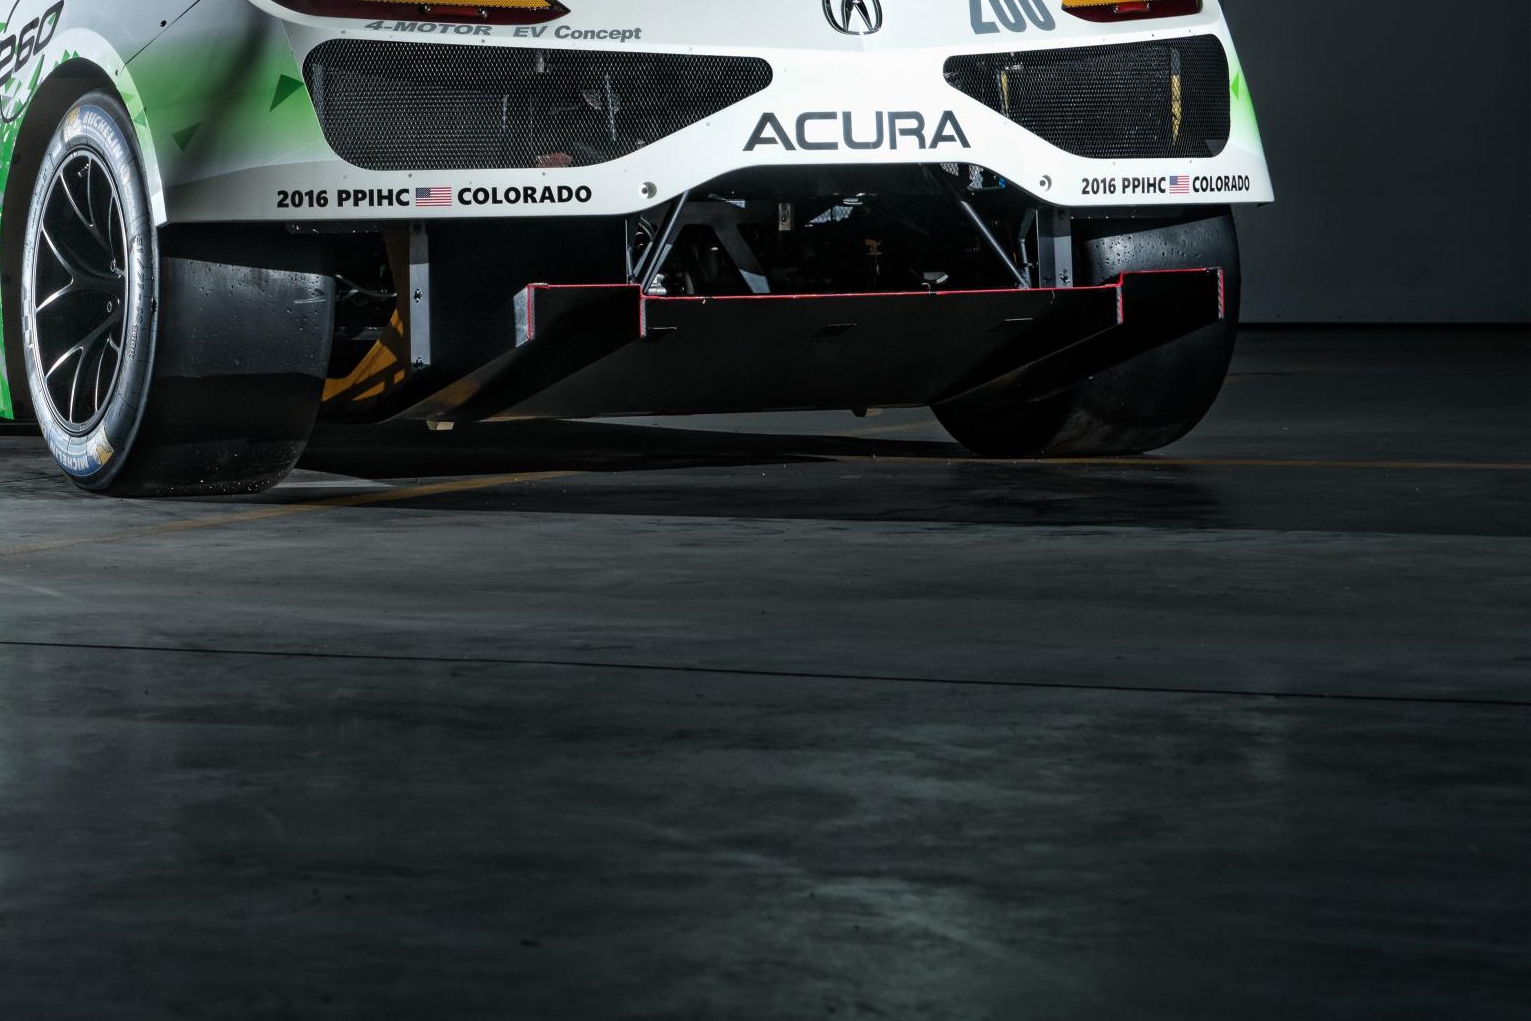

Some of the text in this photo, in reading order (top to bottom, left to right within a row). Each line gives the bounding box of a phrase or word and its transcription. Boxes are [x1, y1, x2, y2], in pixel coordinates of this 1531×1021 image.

[364, 20, 642, 42] 4-MOTOR EV Concept
[82, 111, 124, 158] MICHELIN
[742, 110, 972, 152] ACURA
[276, 185, 592, 209] 2016 PPIHC COLORADO
[1081, 175, 1250, 195] 2016 PPIHC COLORADO
